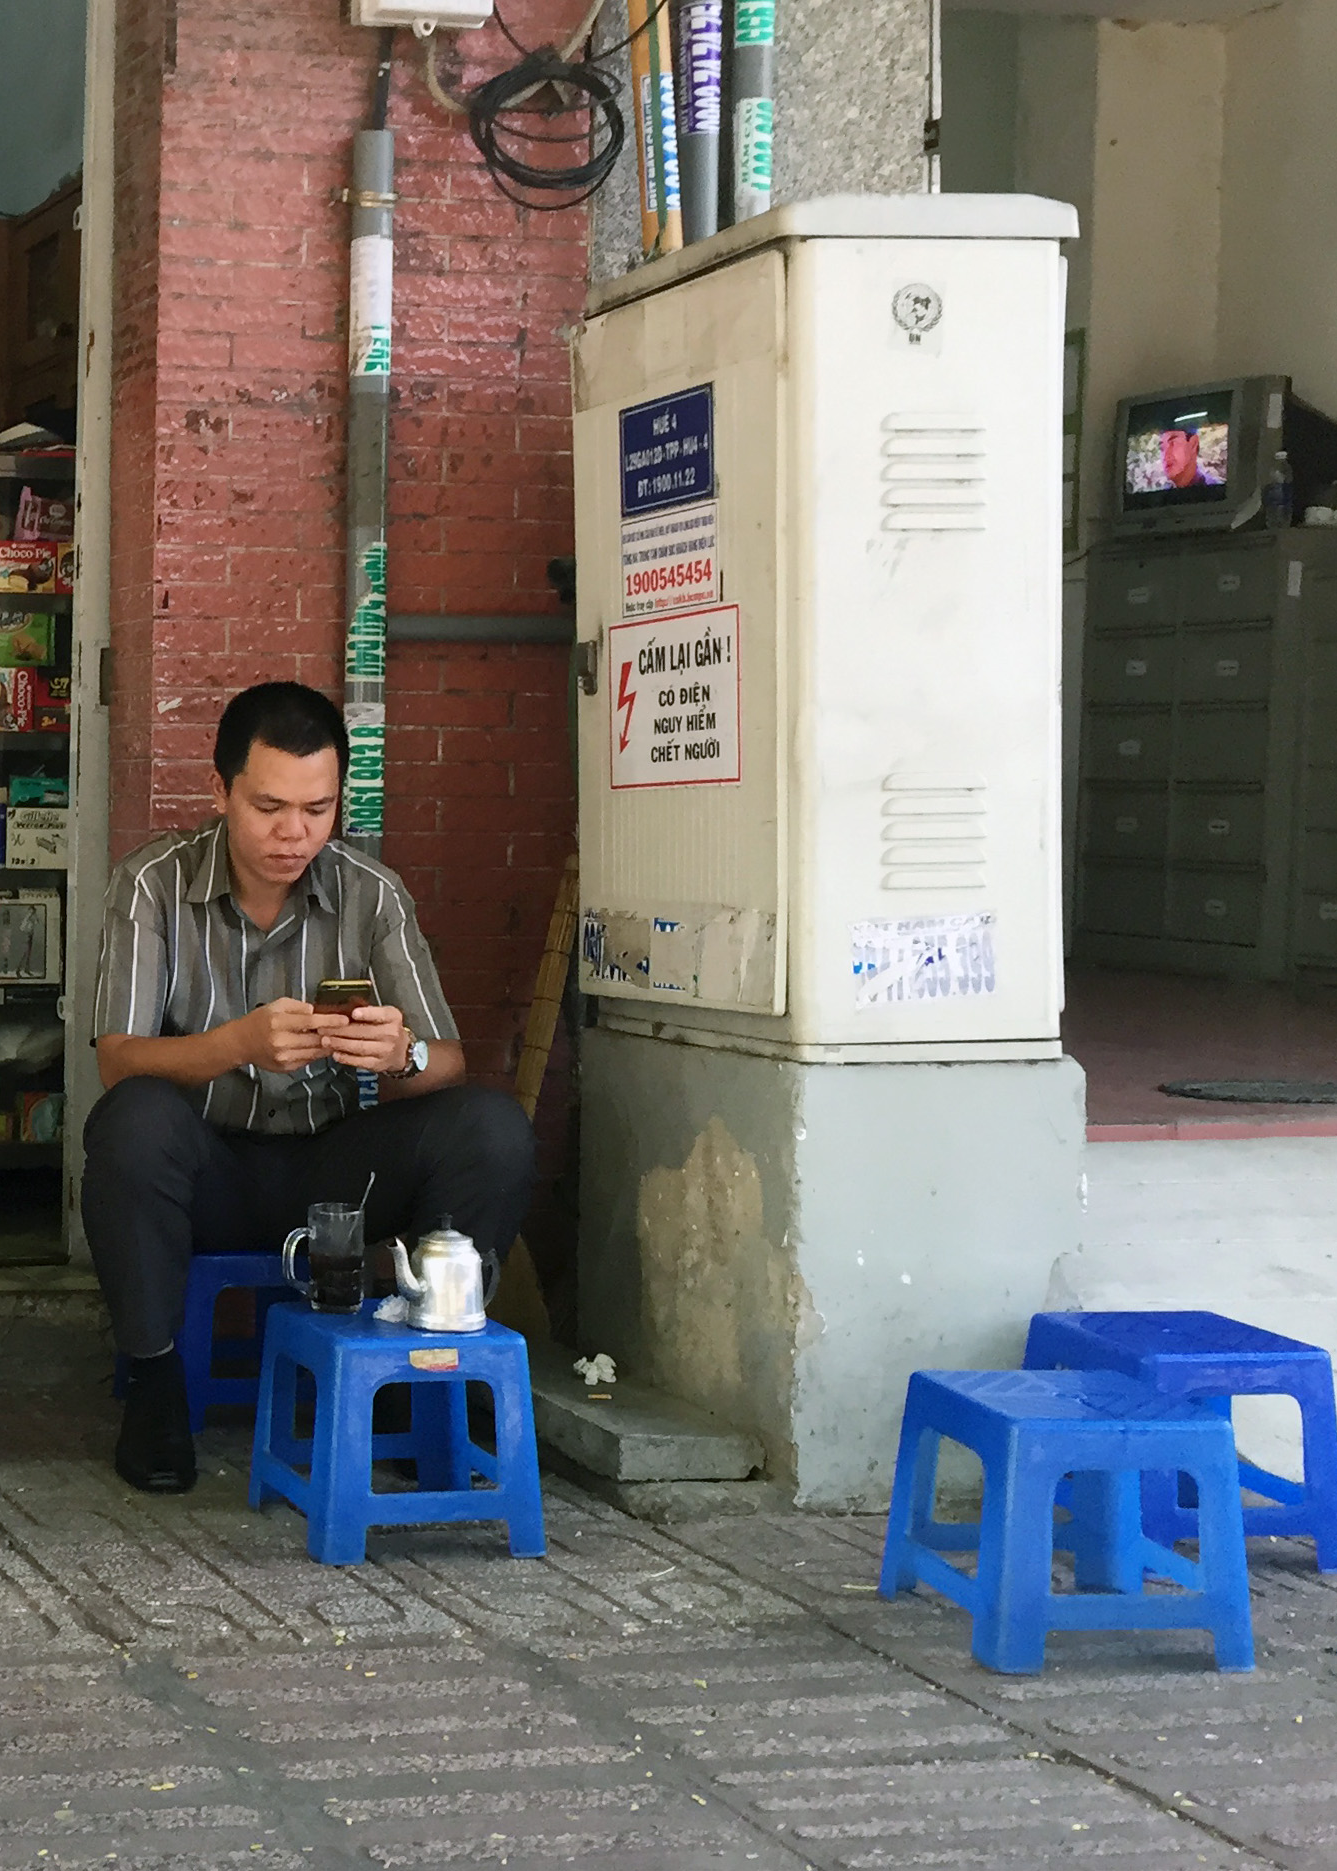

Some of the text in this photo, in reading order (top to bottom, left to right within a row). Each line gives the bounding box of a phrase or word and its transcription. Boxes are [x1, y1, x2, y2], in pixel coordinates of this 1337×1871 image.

[626, 558, 713, 597] 1900545454
[639, 637, 666, 675] CẤM
[670, 642, 690, 675] LẠI
[695, 626, 721, 667] GẦN
[659, 682, 710, 707] CÓ ĐIỆN
[654, 705, 716, 735] NGUY HIỂM
[651, 737, 720, 763] CHẾT NGƯỜI
